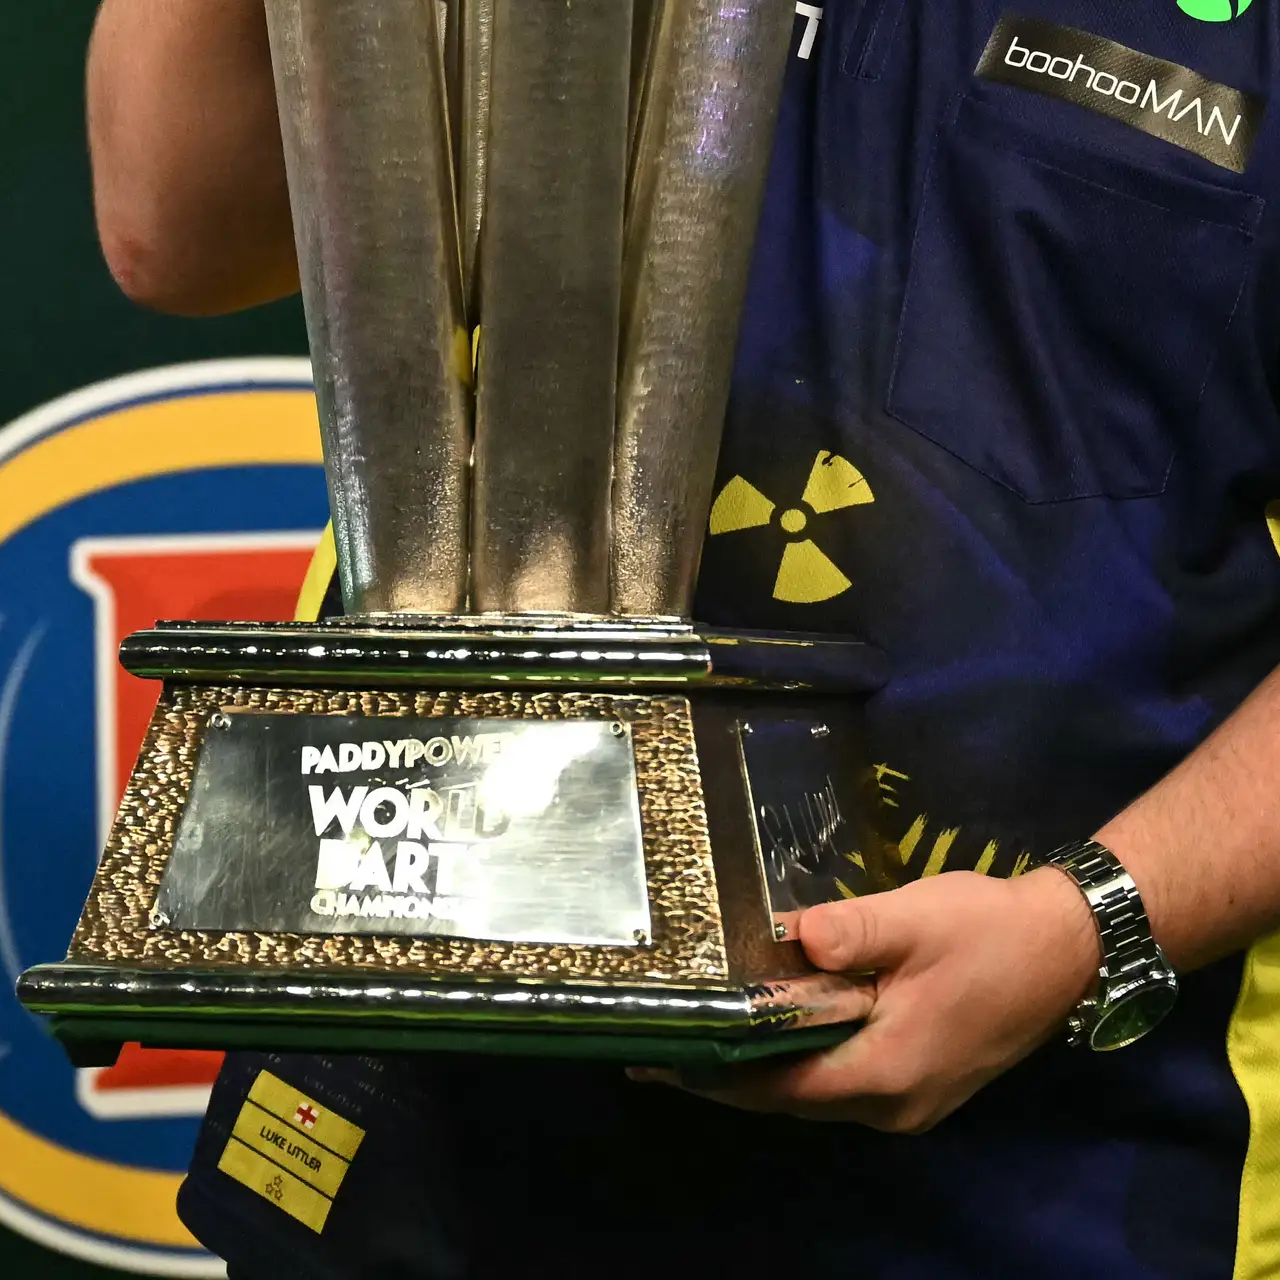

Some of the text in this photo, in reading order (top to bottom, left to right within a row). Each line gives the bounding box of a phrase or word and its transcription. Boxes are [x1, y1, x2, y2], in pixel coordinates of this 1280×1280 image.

[1004, 36, 1242, 145] boohooMAN
[302, 732, 517, 775] PADDYPOWE
[260, 1125, 288, 1152] LUKE
[287, 1144, 322, 1173] LITTLER
